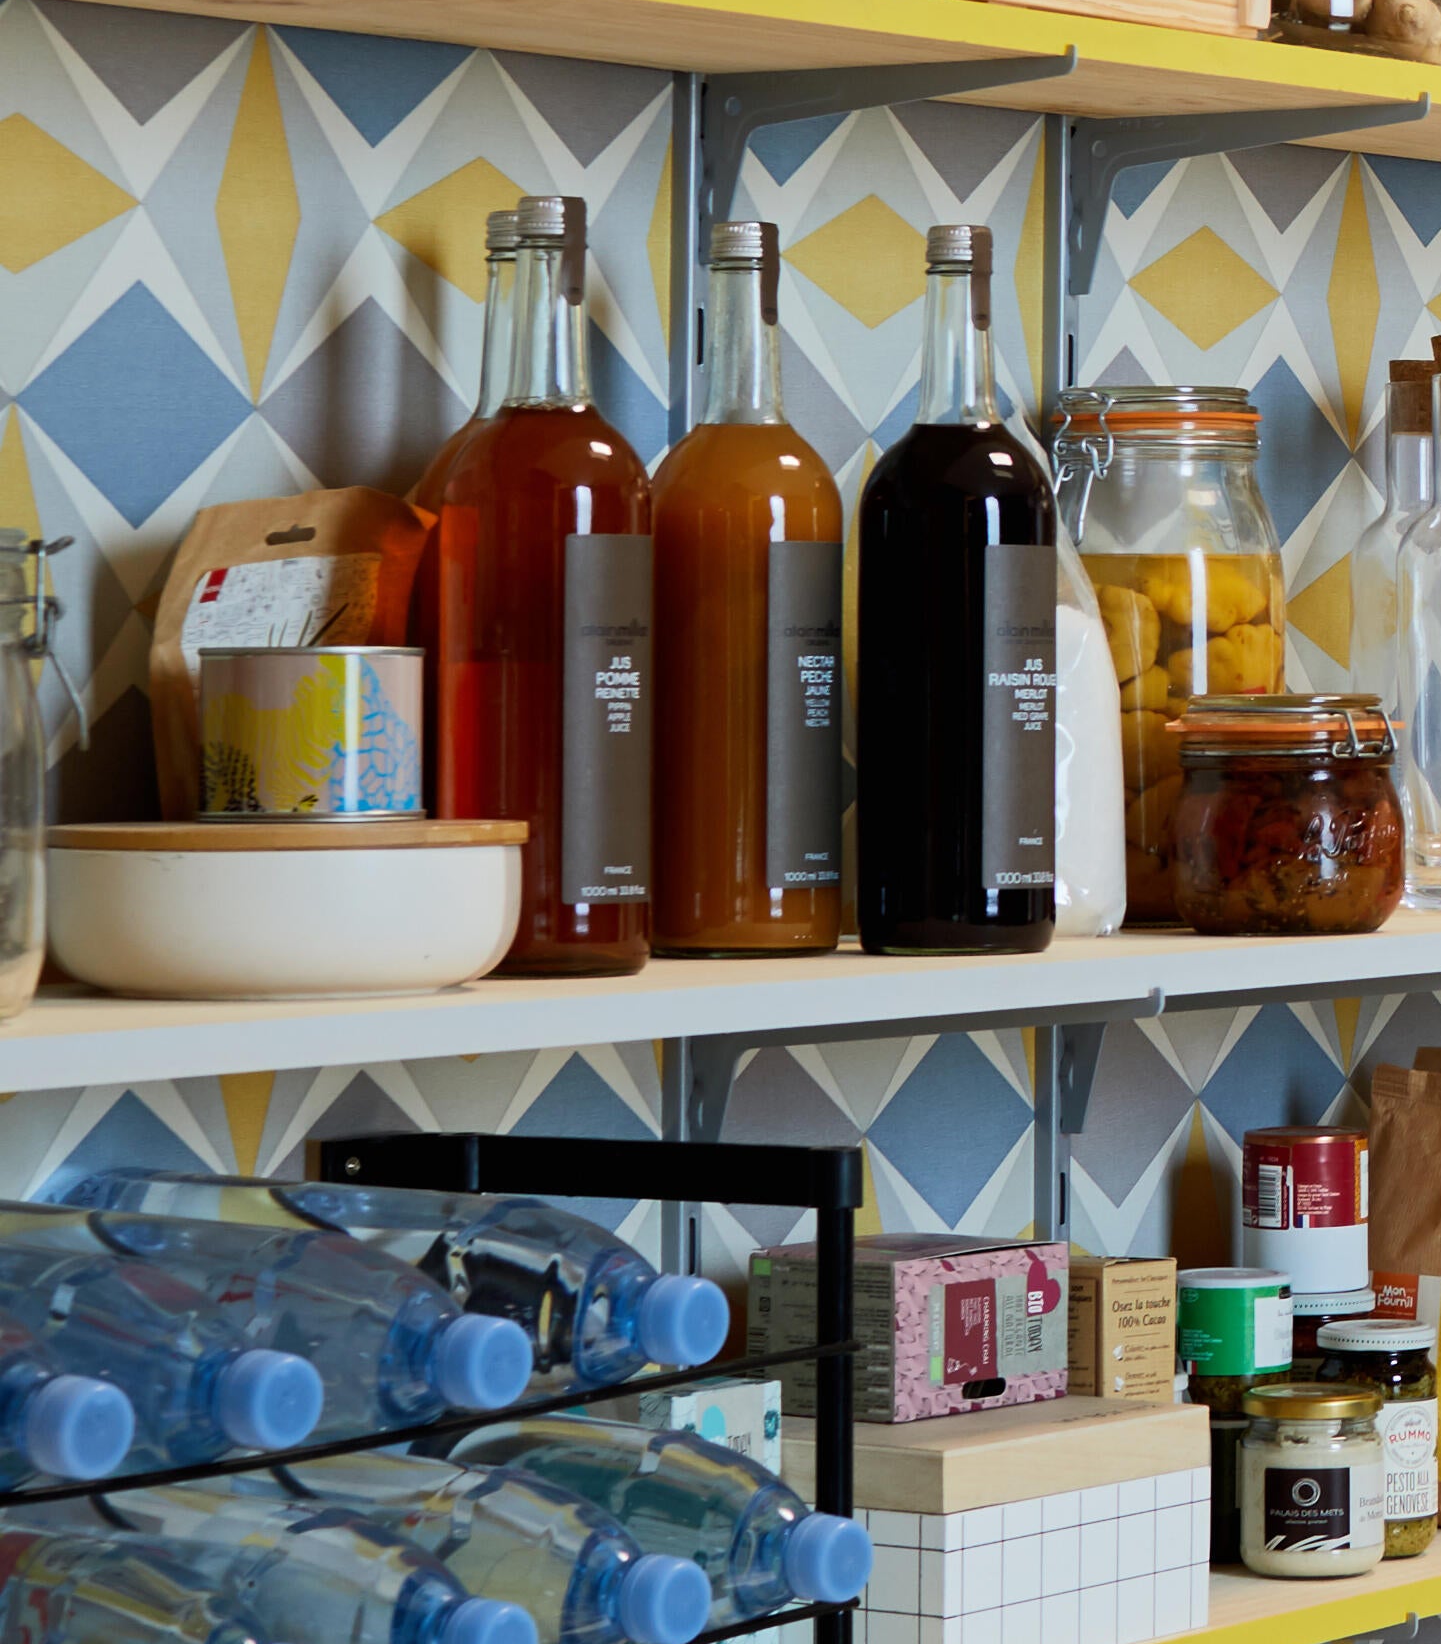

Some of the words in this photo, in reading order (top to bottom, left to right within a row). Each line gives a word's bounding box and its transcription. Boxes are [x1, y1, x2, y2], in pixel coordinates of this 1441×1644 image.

[609, 656, 632, 669] JUS
[797, 655, 836, 668] NECTAR
[1023, 658, 1044, 672] JUS
[595, 671, 641, 686] POMME
[988, 673, 1031, 688] RAISIN
[804, 684, 832, 697] JAUNE
[1014, 688, 1048, 701] MERLOT
[1382, 1284, 1407, 1297] Mon
[1027, 1290, 1045, 1314] BIO
[1111, 1299, 1133, 1313] Osez
[1145, 1296, 1172, 1309] touche
[1377, 1296, 1414, 1309] Fournil
[1142, 1313, 1167, 1326] Cacao
[1027, 1315, 1044, 1354] TODAY
[1388, 1430, 1432, 1445] RUMMO
[1386, 1471, 1416, 1493] PESTO
[1386, 1491, 1430, 1516] GENOVESE
[1269, 1508, 1301, 1518] PALAIS
[1301, 1509, 1319, 1518] DES
[1320, 1508, 1345, 1517] METS
